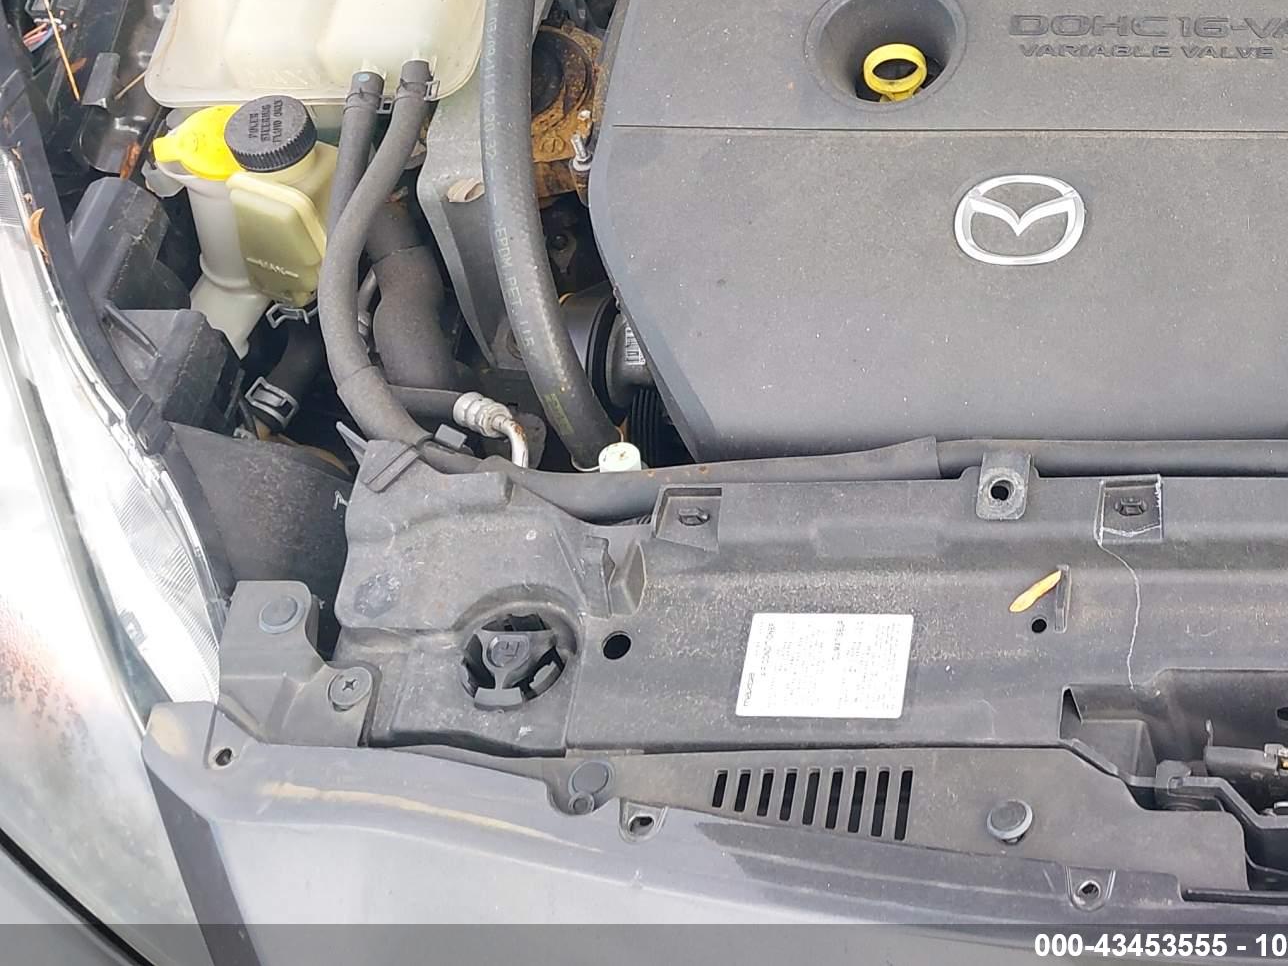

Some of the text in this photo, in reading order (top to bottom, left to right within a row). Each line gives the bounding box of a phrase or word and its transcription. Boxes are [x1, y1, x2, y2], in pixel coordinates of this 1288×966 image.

[1010, 14, 1170, 37] DOHC
[1018, 43, 1174, 59] VARIABLE
[1180, 45, 1275, 60] VALVE
